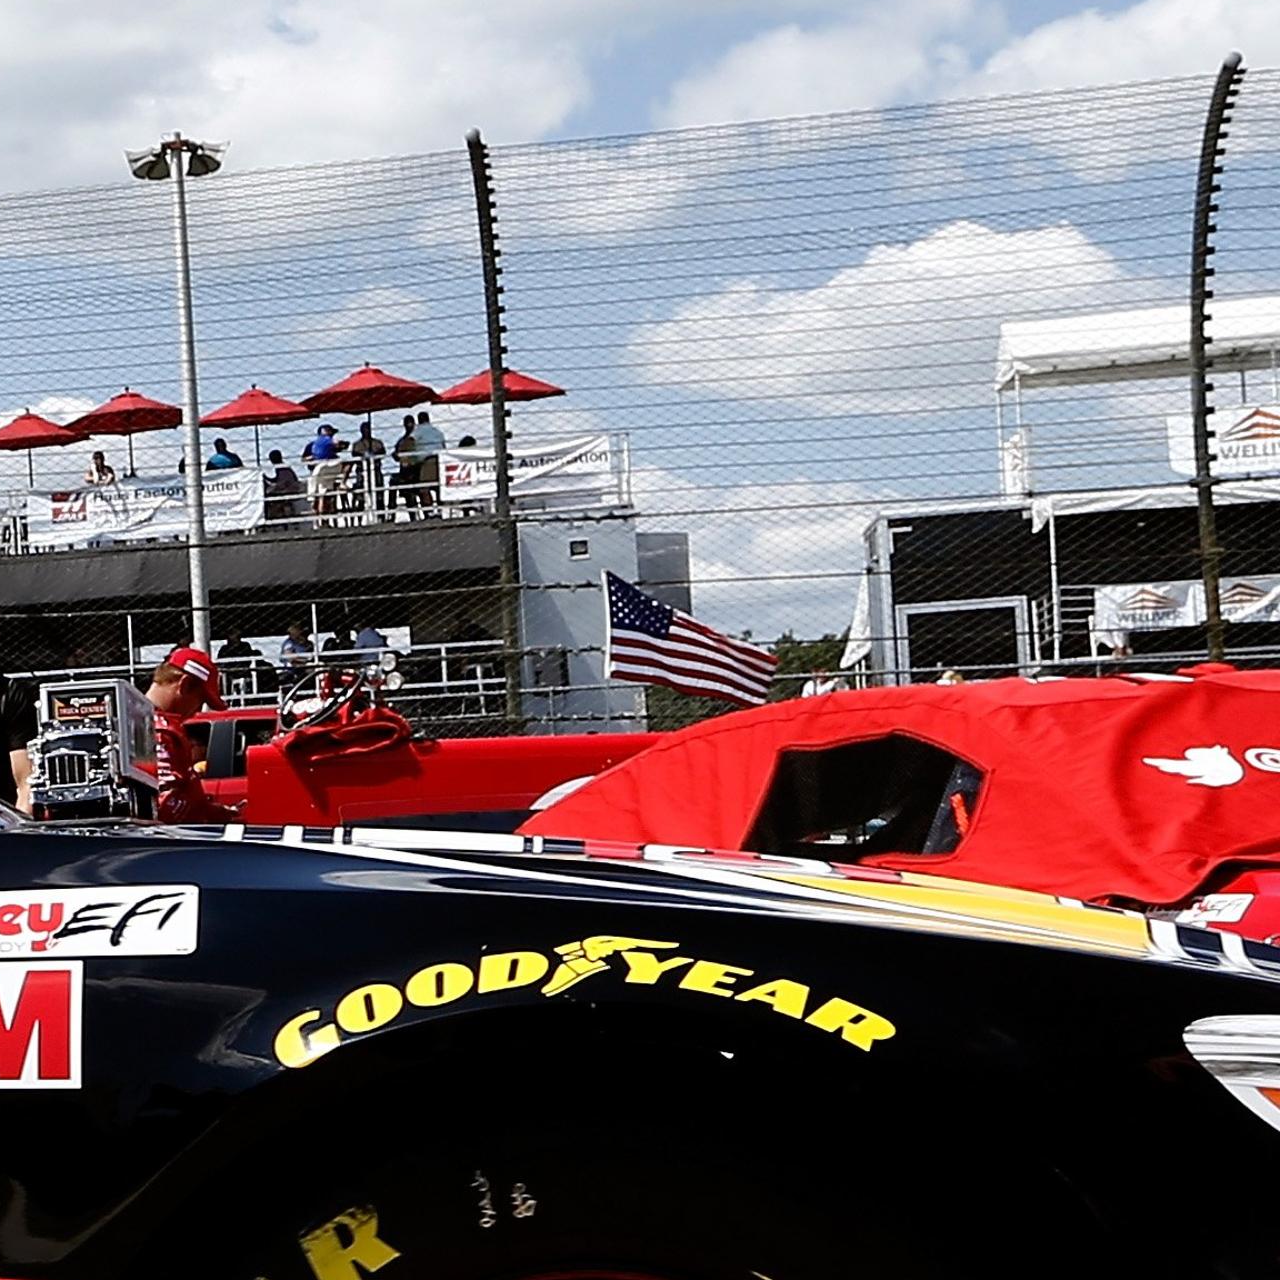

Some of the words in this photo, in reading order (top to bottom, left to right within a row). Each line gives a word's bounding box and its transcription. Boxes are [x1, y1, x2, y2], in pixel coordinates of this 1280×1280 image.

[1220, 441, 1280, 460] WELLI
[134, 486, 188, 501] Factory
[197, 480, 240, 495] utlet
[53, 892, 187, 947] EFI
